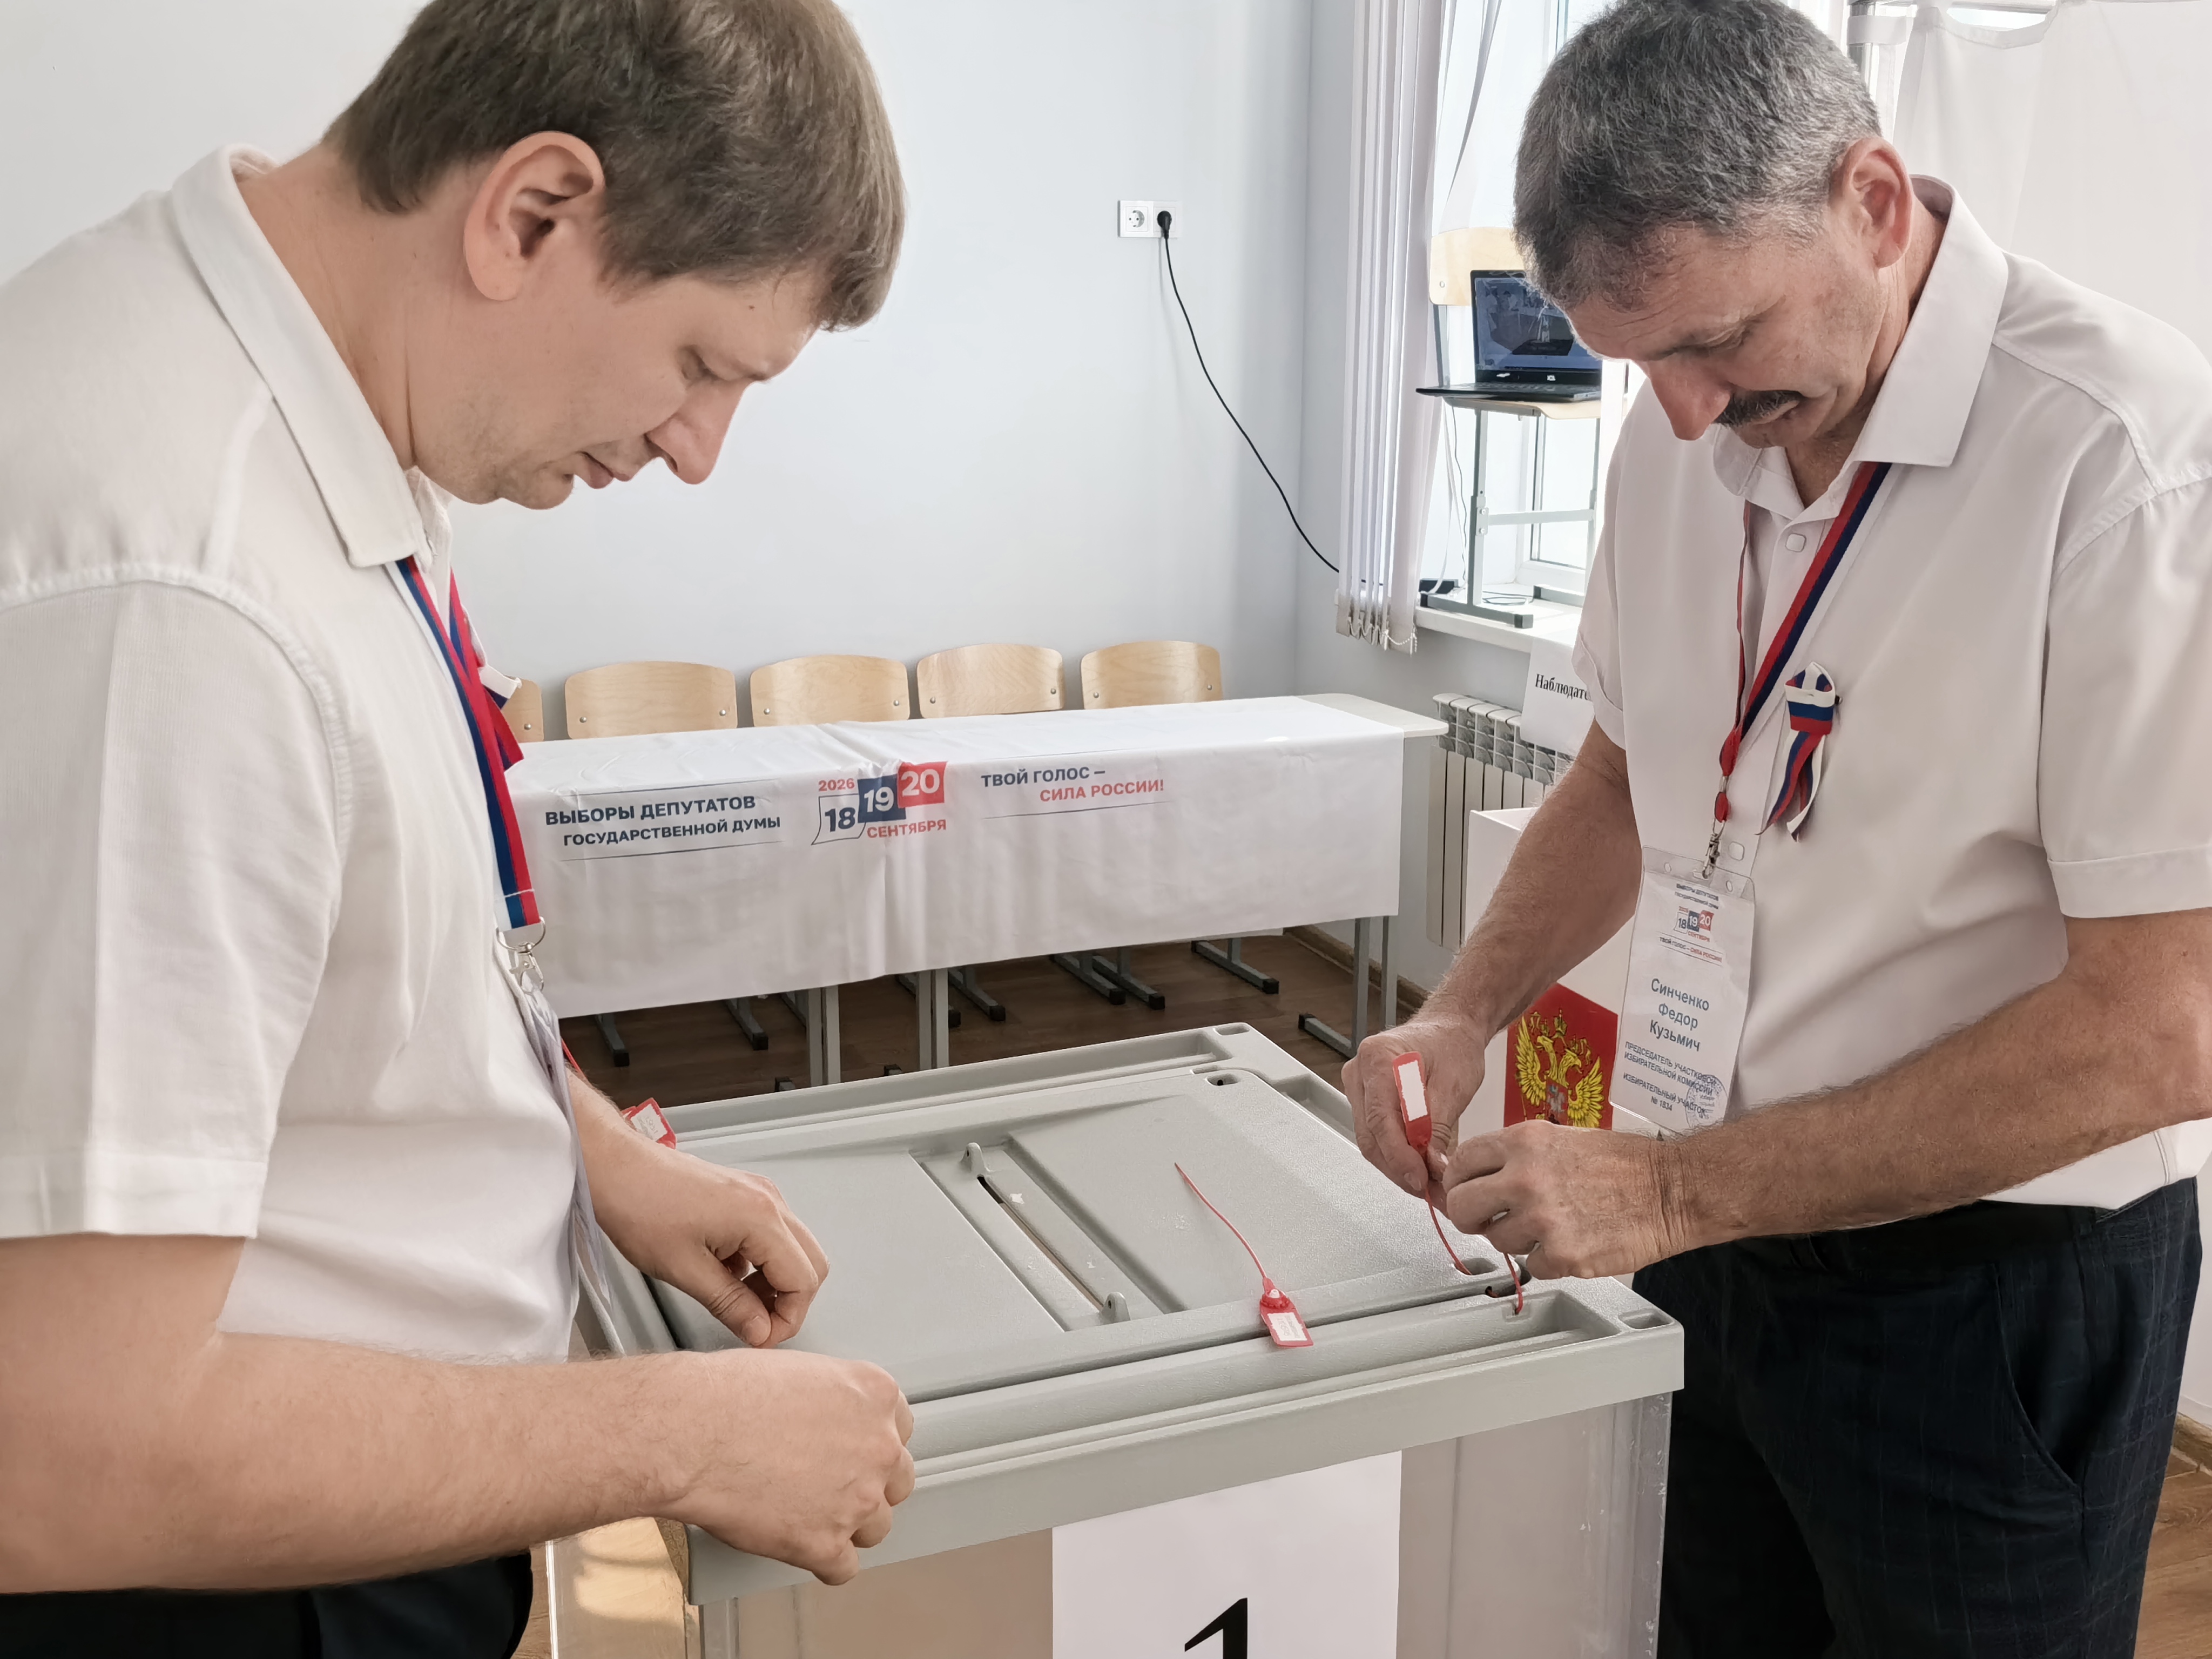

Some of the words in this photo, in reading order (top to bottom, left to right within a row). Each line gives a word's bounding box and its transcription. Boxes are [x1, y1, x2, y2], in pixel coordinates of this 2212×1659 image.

[818, 778, 855, 791] 2026
[981, 768, 1028, 787] ТВОЙ
[1033, 767, 1090, 783] ГОЛОС
[1040, 787, 1087, 802] СИЛА
[1091, 779, 1164, 797] РОССИИ!
[545, 805, 635, 825] ВЫБОРЫ
[640, 795, 756, 820] ДЕПУТАТОВ
[824, 808, 856, 832] 18
[864, 787, 894, 813] 19
[901, 770, 940, 797] 20
[564, 819, 728, 846] ГОСУДАРСТВЕННОЙ
[732, 817, 781, 833] ДУМЫ
[867, 819, 947, 839] СЕНТЯБРЯ
[1678, 918, 1687, 929] 18
[1689, 915, 1698, 927] 19
[1700, 914, 1711, 926] 20
[1651, 978, 1709, 1011] Синченко
[1658, 1003, 1698, 1031] Федор
[1650, 1019, 1701, 1052] Кузьмич
[1624, 1051, 1676, 1080] ИЗБИРАТЕЛЬНОЙ
[1625, 1041, 1673, 1067] ПРЕДСЕДАТЕЛЬ
[1623, 1072, 1676, 1102] ИЗБИРАТЕЛЬНЫЙ
